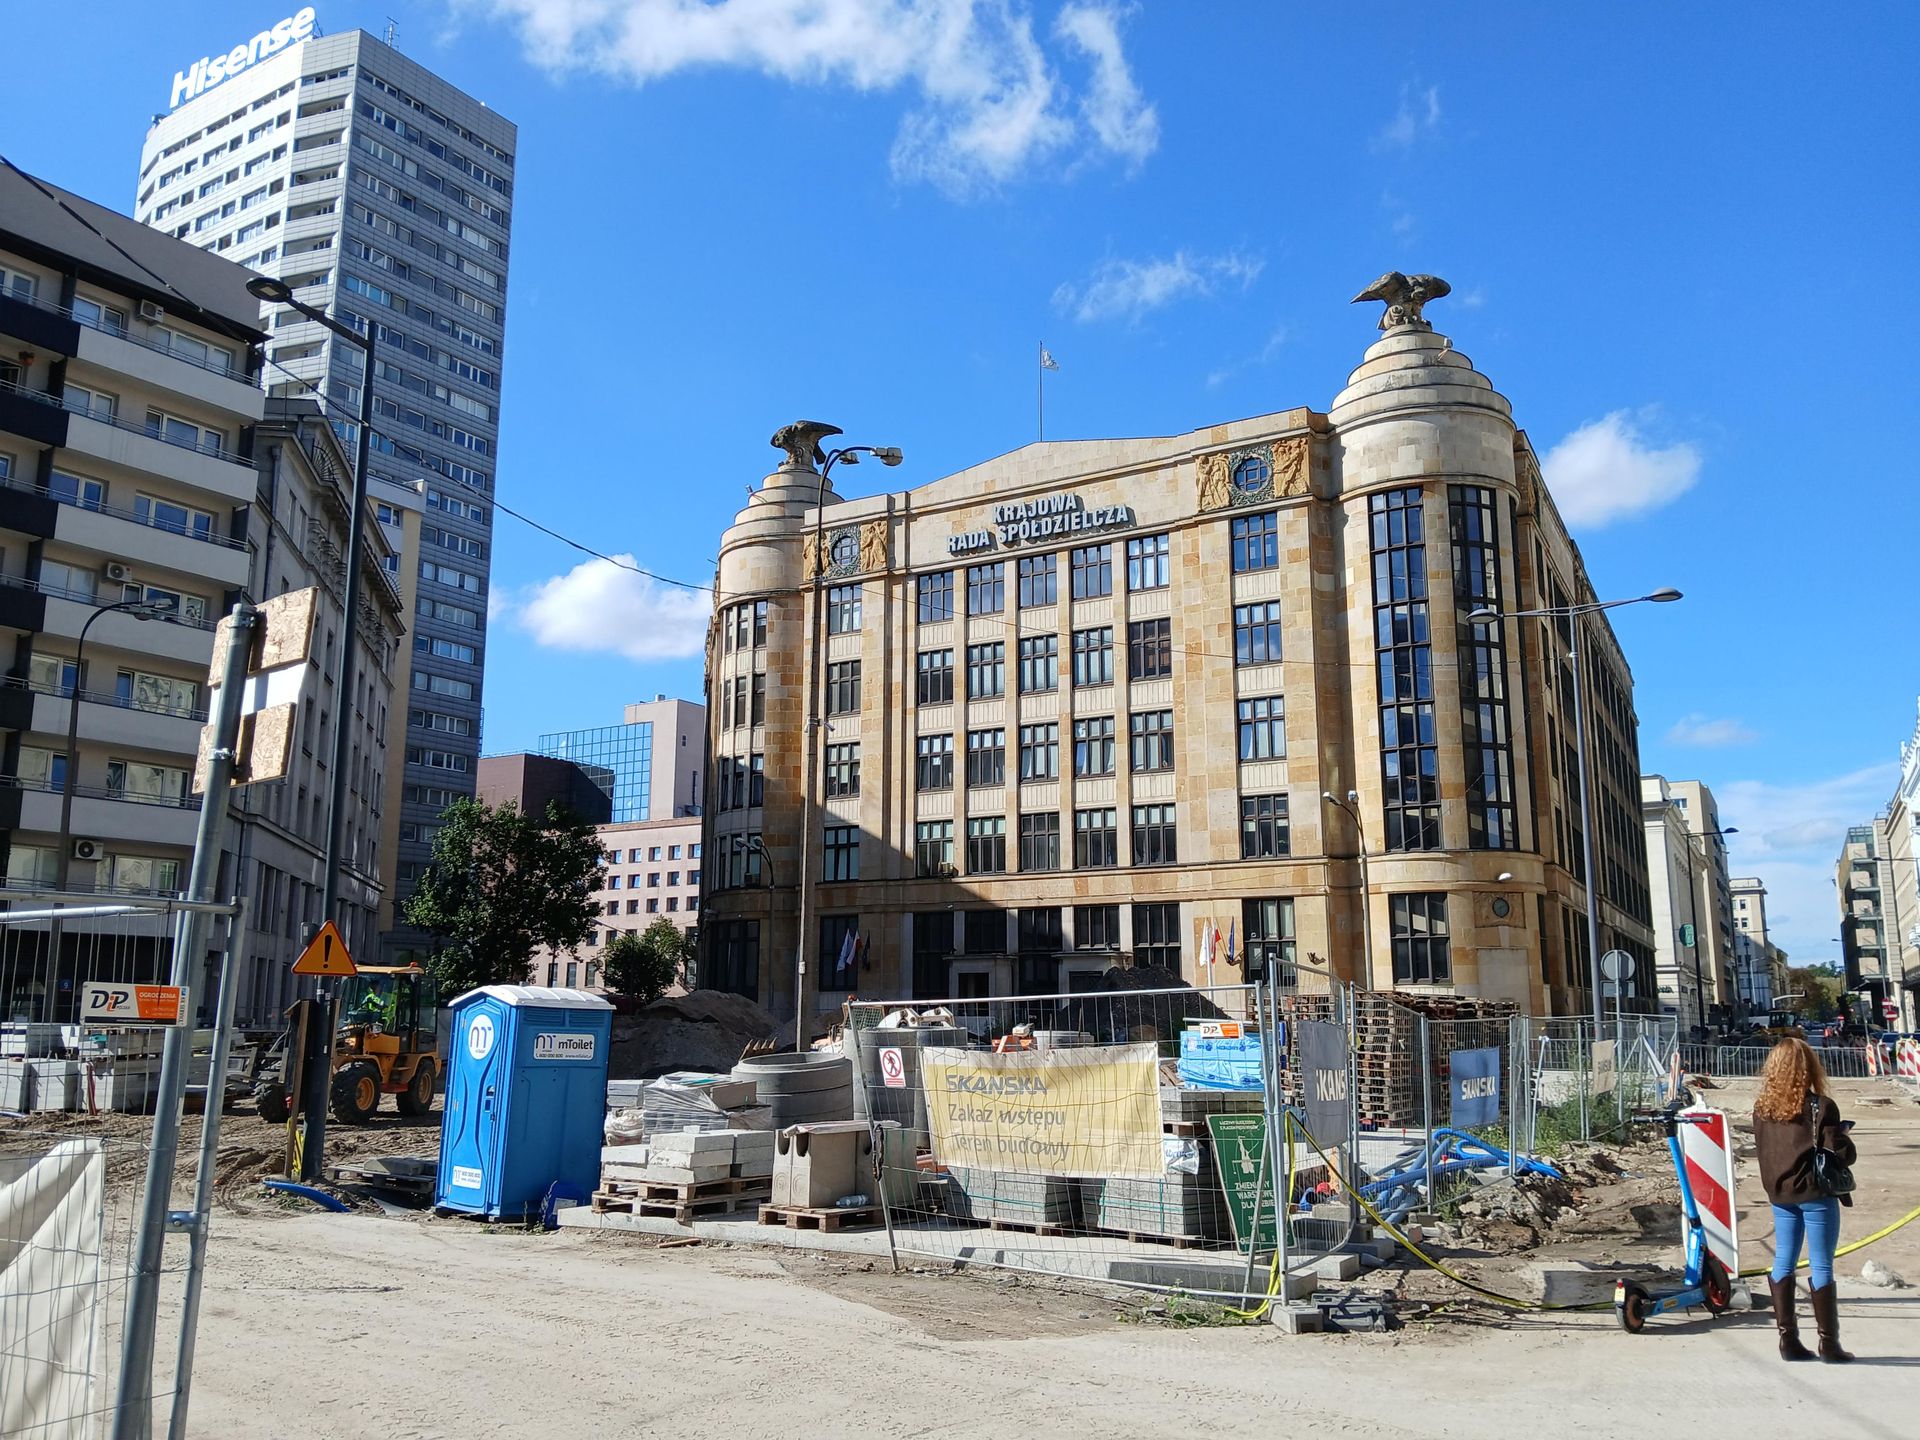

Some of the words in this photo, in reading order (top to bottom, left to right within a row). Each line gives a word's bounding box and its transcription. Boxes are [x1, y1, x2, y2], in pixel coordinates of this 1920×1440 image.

[169, 6, 315, 109] Hisense
[992, 492, 1077, 524] KRAJOWA
[947, 528, 990, 552] RADA
[998, 504, 1129, 544] SPÓŁDZIELCZA
[558, 1038, 593, 1050] mToilet
[945, 1074, 1048, 1096] SKANSKA
[948, 1103, 993, 1123] Zakaz
[999, 1106, 1065, 1130] wstępu
[999, 1134, 1070, 1162] budowy
